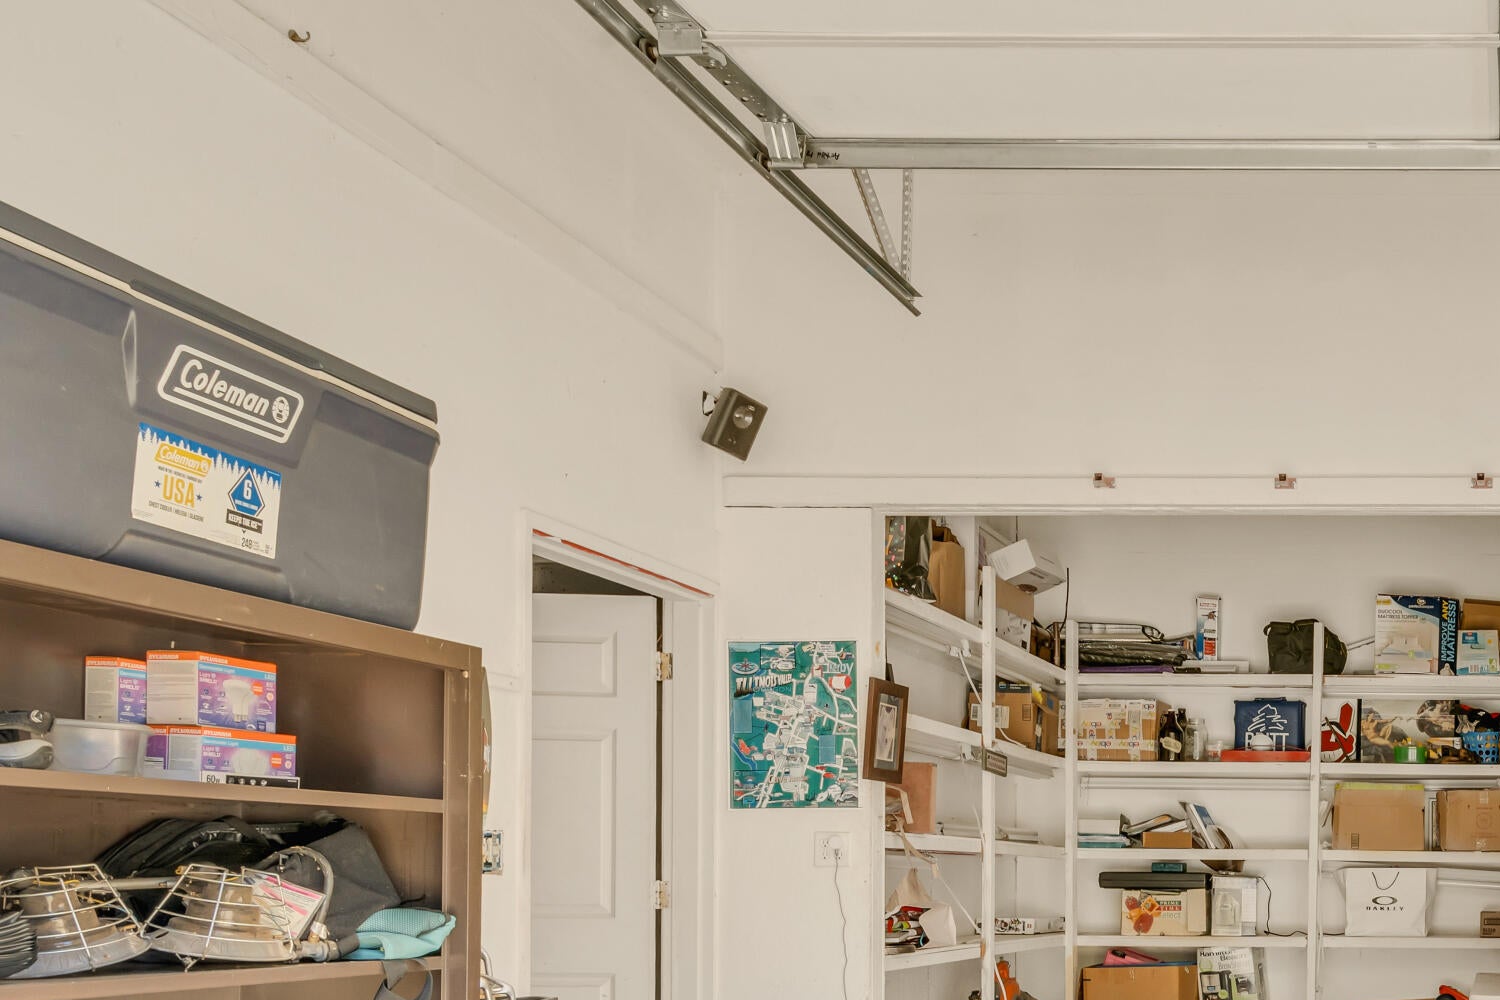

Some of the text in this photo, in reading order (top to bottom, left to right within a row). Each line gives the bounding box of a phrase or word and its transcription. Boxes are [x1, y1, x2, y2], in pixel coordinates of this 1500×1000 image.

[180, 358, 270, 417] Coleman
[160, 445, 201, 471] Coleman
[162, 474, 195, 508] USA
[243, 479, 253, 500] 6
[1440, 600, 1449, 662] IMPROVE ANY
